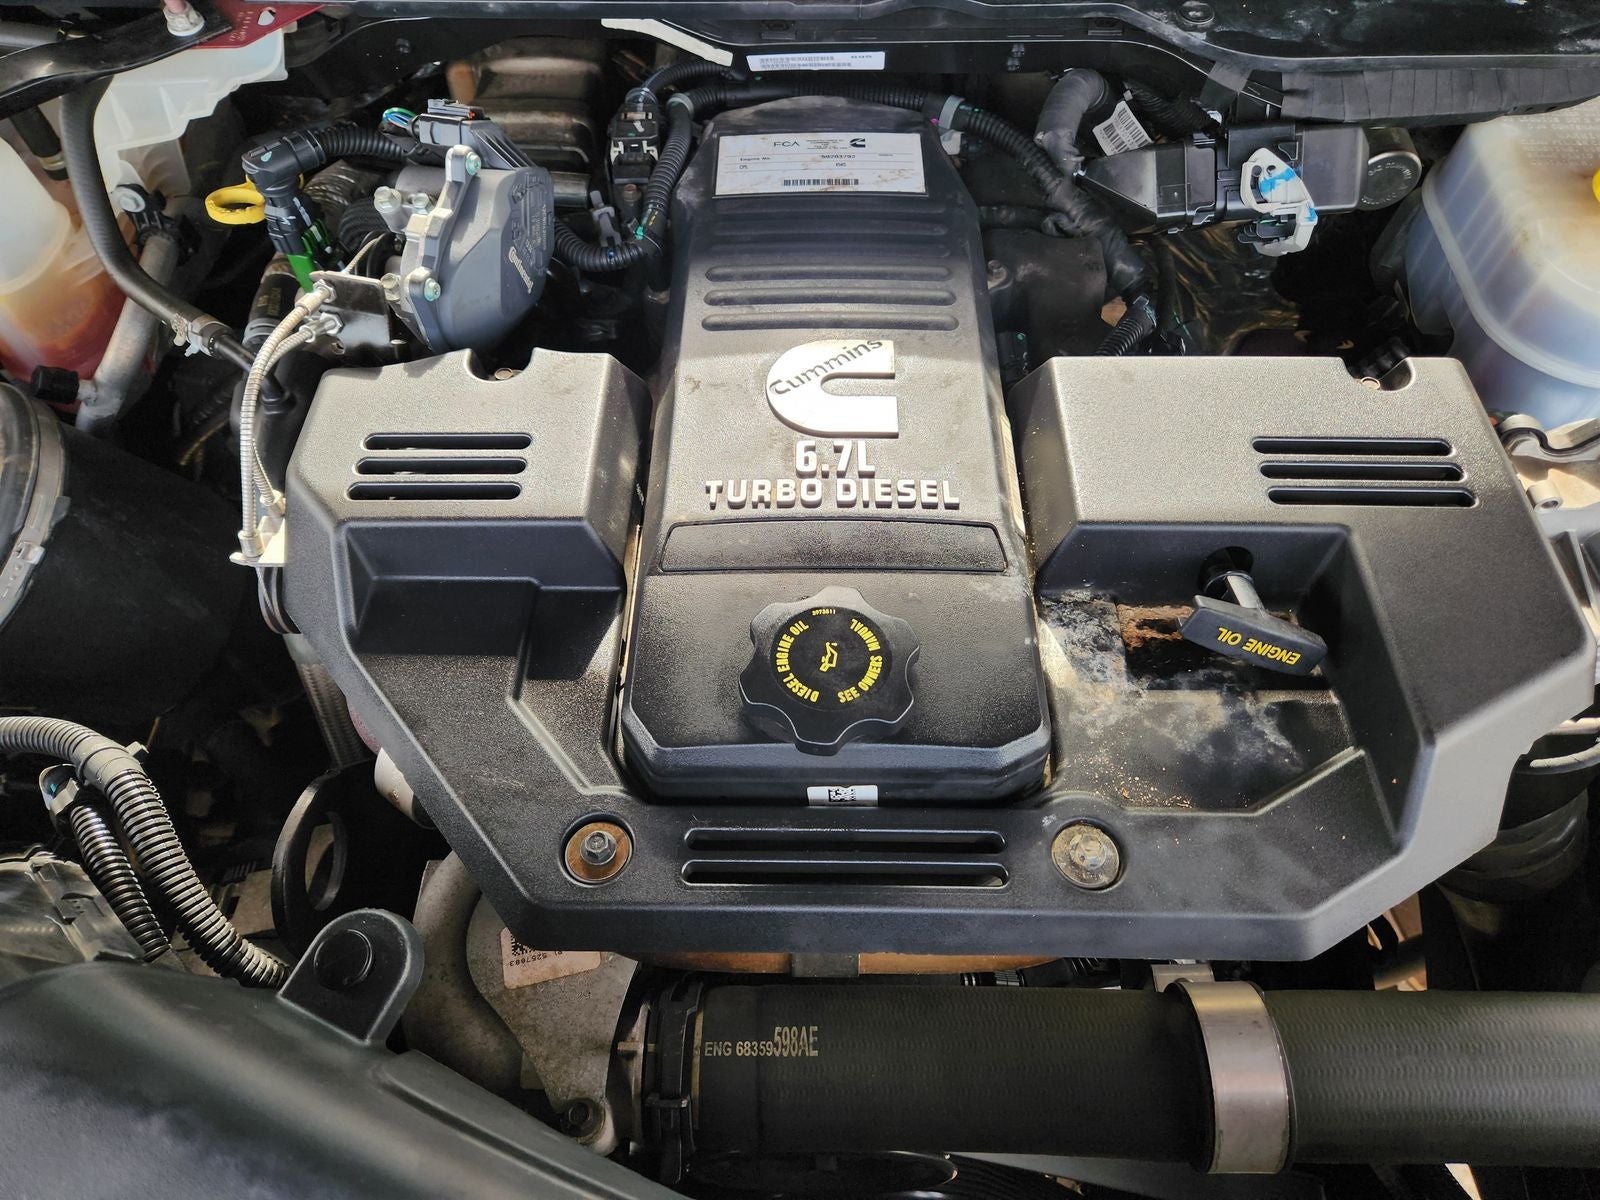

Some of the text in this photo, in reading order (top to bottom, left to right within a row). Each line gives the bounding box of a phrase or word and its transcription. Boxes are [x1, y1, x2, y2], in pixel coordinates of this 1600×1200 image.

[769, 339, 883, 394] Cummins
[796, 439, 875, 478] 6.7L
[705, 478, 960, 510] TURBO DIESEL
[776, 620, 820, 703] DIESEL ENGINE OIL
[837, 618, 883, 703] SEE OWNERS MANUAL
[1217, 627, 1301, 665] ENGINE OIL
[704, 1041, 732, 1057] ENG
